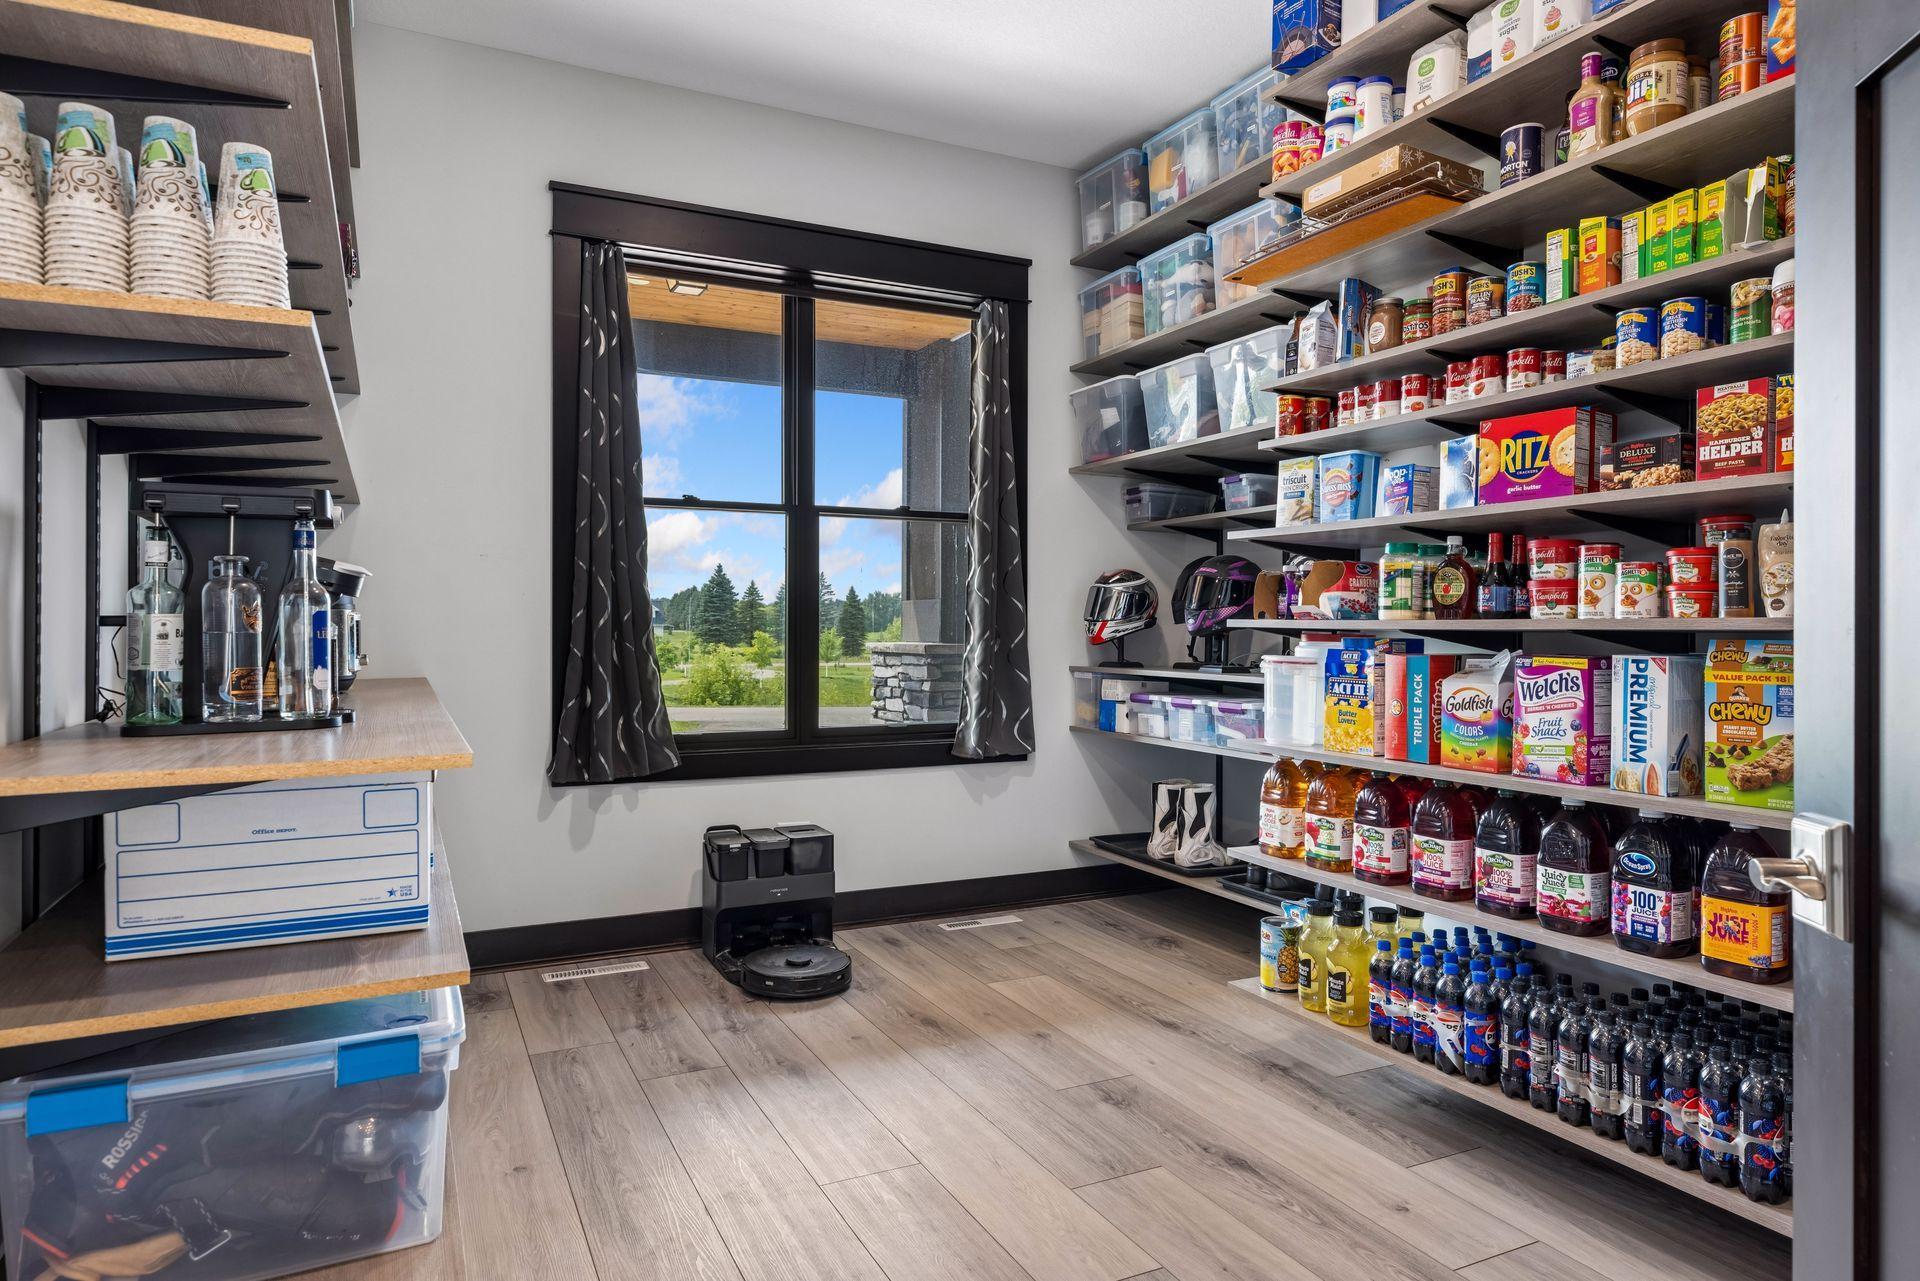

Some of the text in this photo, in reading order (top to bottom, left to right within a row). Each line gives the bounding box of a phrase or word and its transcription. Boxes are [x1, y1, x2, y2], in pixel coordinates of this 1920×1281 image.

[1499, 23, 1519, 37] sugar
[1511, 267, 1534, 278] BUSH'S
[1709, 435, 1751, 445] HAMBURGER
[1501, 435, 1549, 473] RITZ
[1620, 446, 1656, 458] DELUXE
[1699, 440, 1763, 461] HELPER
[1283, 474, 1307, 485] triscuit
[1507, 486, 1522, 494] garlic
[1536, 591, 1568, 600] Campbell's
[1746, 674, 1771, 682] PACK
[1333, 682, 1351, 695] ACT
[1519, 672, 1580, 701] Welch's
[1413, 673, 1423, 745] TRIPLE PACK
[1446, 694, 1493, 713] Goldfish
[1338, 709, 1357, 717] Butter
[1629, 658, 1649, 764] PREMIUM
[1338, 716, 1356, 725] Lovers
[1539, 717, 1562, 728] Fruit
[1454, 723, 1484, 737] COLORS
[1531, 725, 1567, 738] Snacks
[1421, 842, 1444, 853] ORCHARD
[1426, 854, 1443, 864] 100%
[1487, 857, 1512, 868] ORCHARD
[1423, 860, 1443, 871] JUICE
[1493, 869, 1513, 879] 100%
[1542, 868, 1567, 883] Juicy
[1490, 876, 1513, 887] JUICE
[1543, 878, 1565, 888] Juice
[1631, 890, 1664, 911] 100%
[1632, 907, 1658, 918] JUICE
